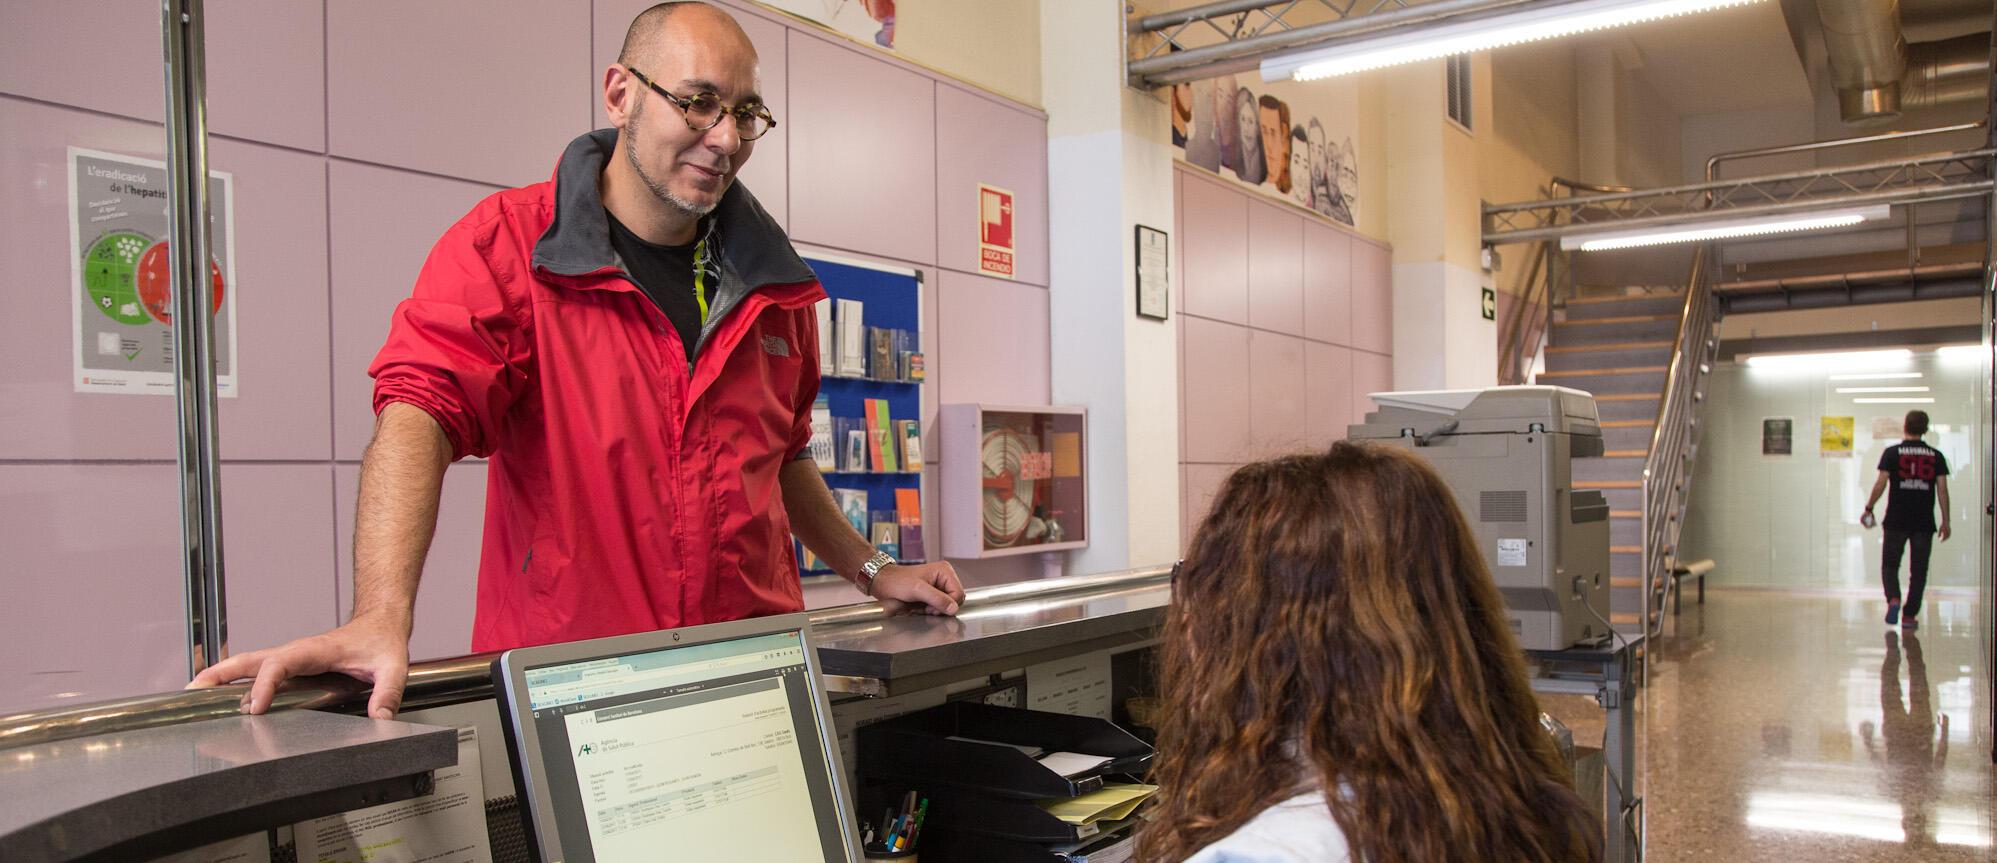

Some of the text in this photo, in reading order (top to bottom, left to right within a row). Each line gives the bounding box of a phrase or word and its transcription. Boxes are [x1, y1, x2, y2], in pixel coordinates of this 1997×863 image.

[87, 165, 148, 184] L'eradicació
[110, 183, 168, 199] de l'hepatiti
[983, 249, 1011, 263] BOCA DE
[983, 260, 1011, 274] INCENDIO
